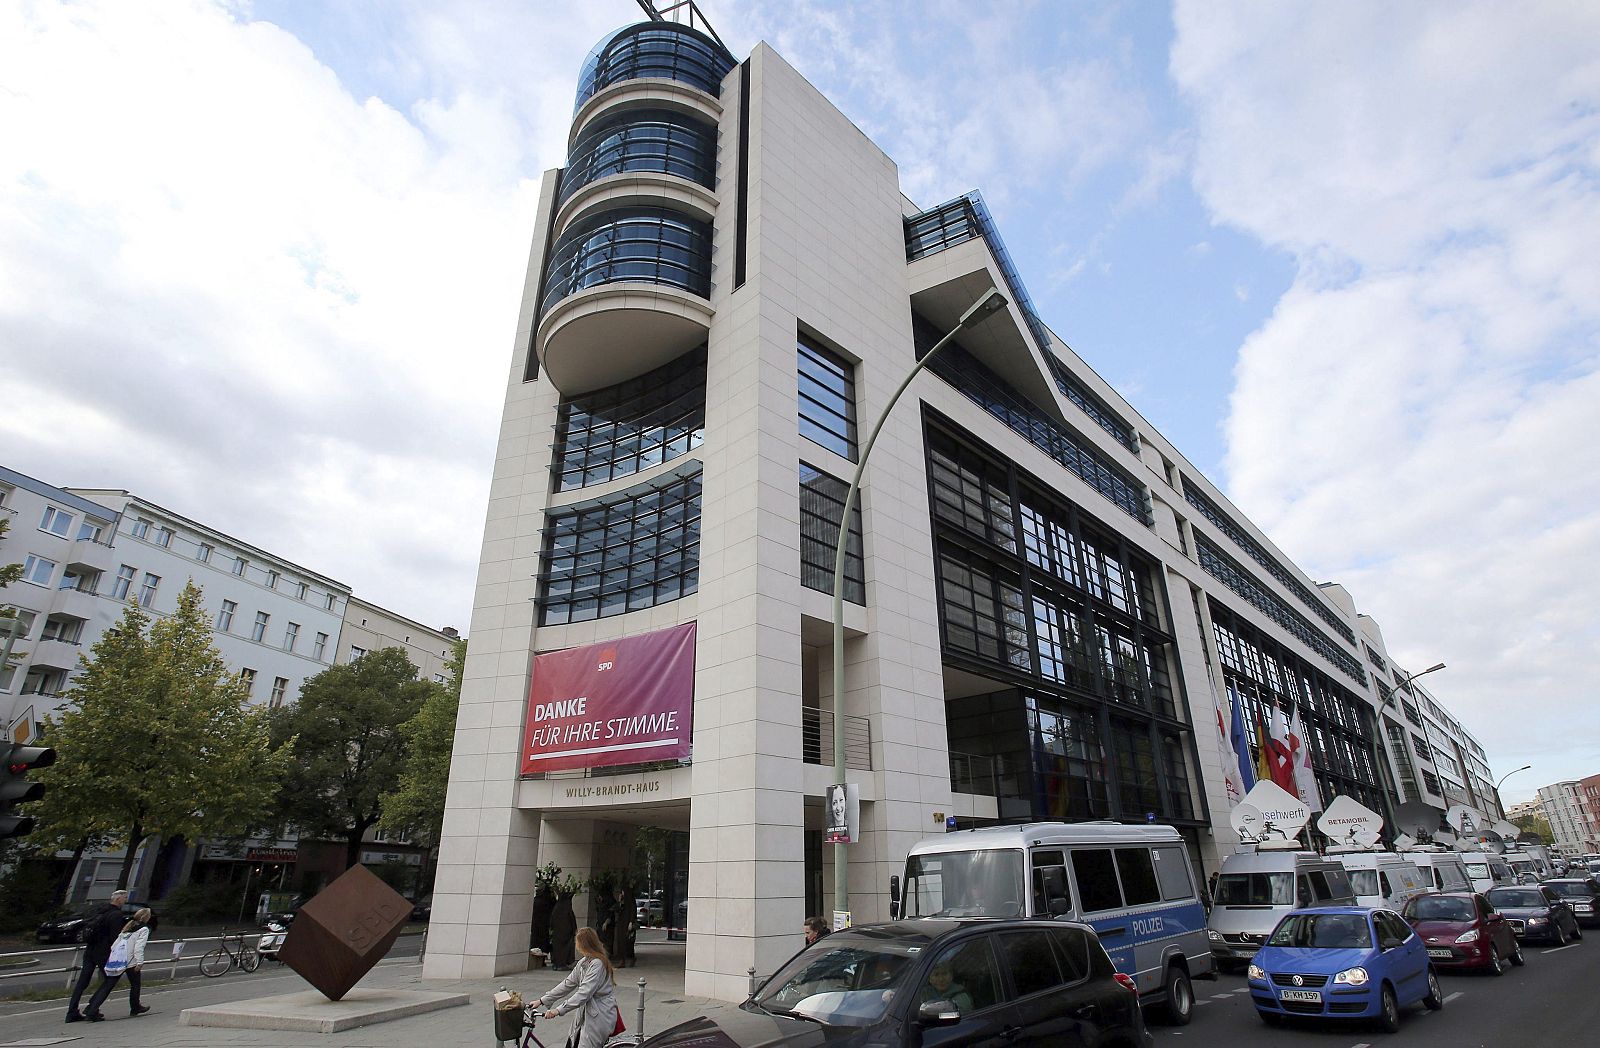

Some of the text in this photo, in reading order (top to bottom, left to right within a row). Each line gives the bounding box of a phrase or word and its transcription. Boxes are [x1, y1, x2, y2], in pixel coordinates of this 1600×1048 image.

[598, 661, 612, 672] SPD
[534, 697, 586, 721] DANKE
[531, 711, 679, 748] FÜR IHRE STIMME.
[566, 781, 660, 798] WILLY-BRANDT-HAUS
[1328, 816, 1369, 825] BETAMOBIL
[346, 904, 401, 950] SPD
[1132, 917, 1164, 936] POLIZEI
[1283, 990, 1318, 1000] B KH 159
